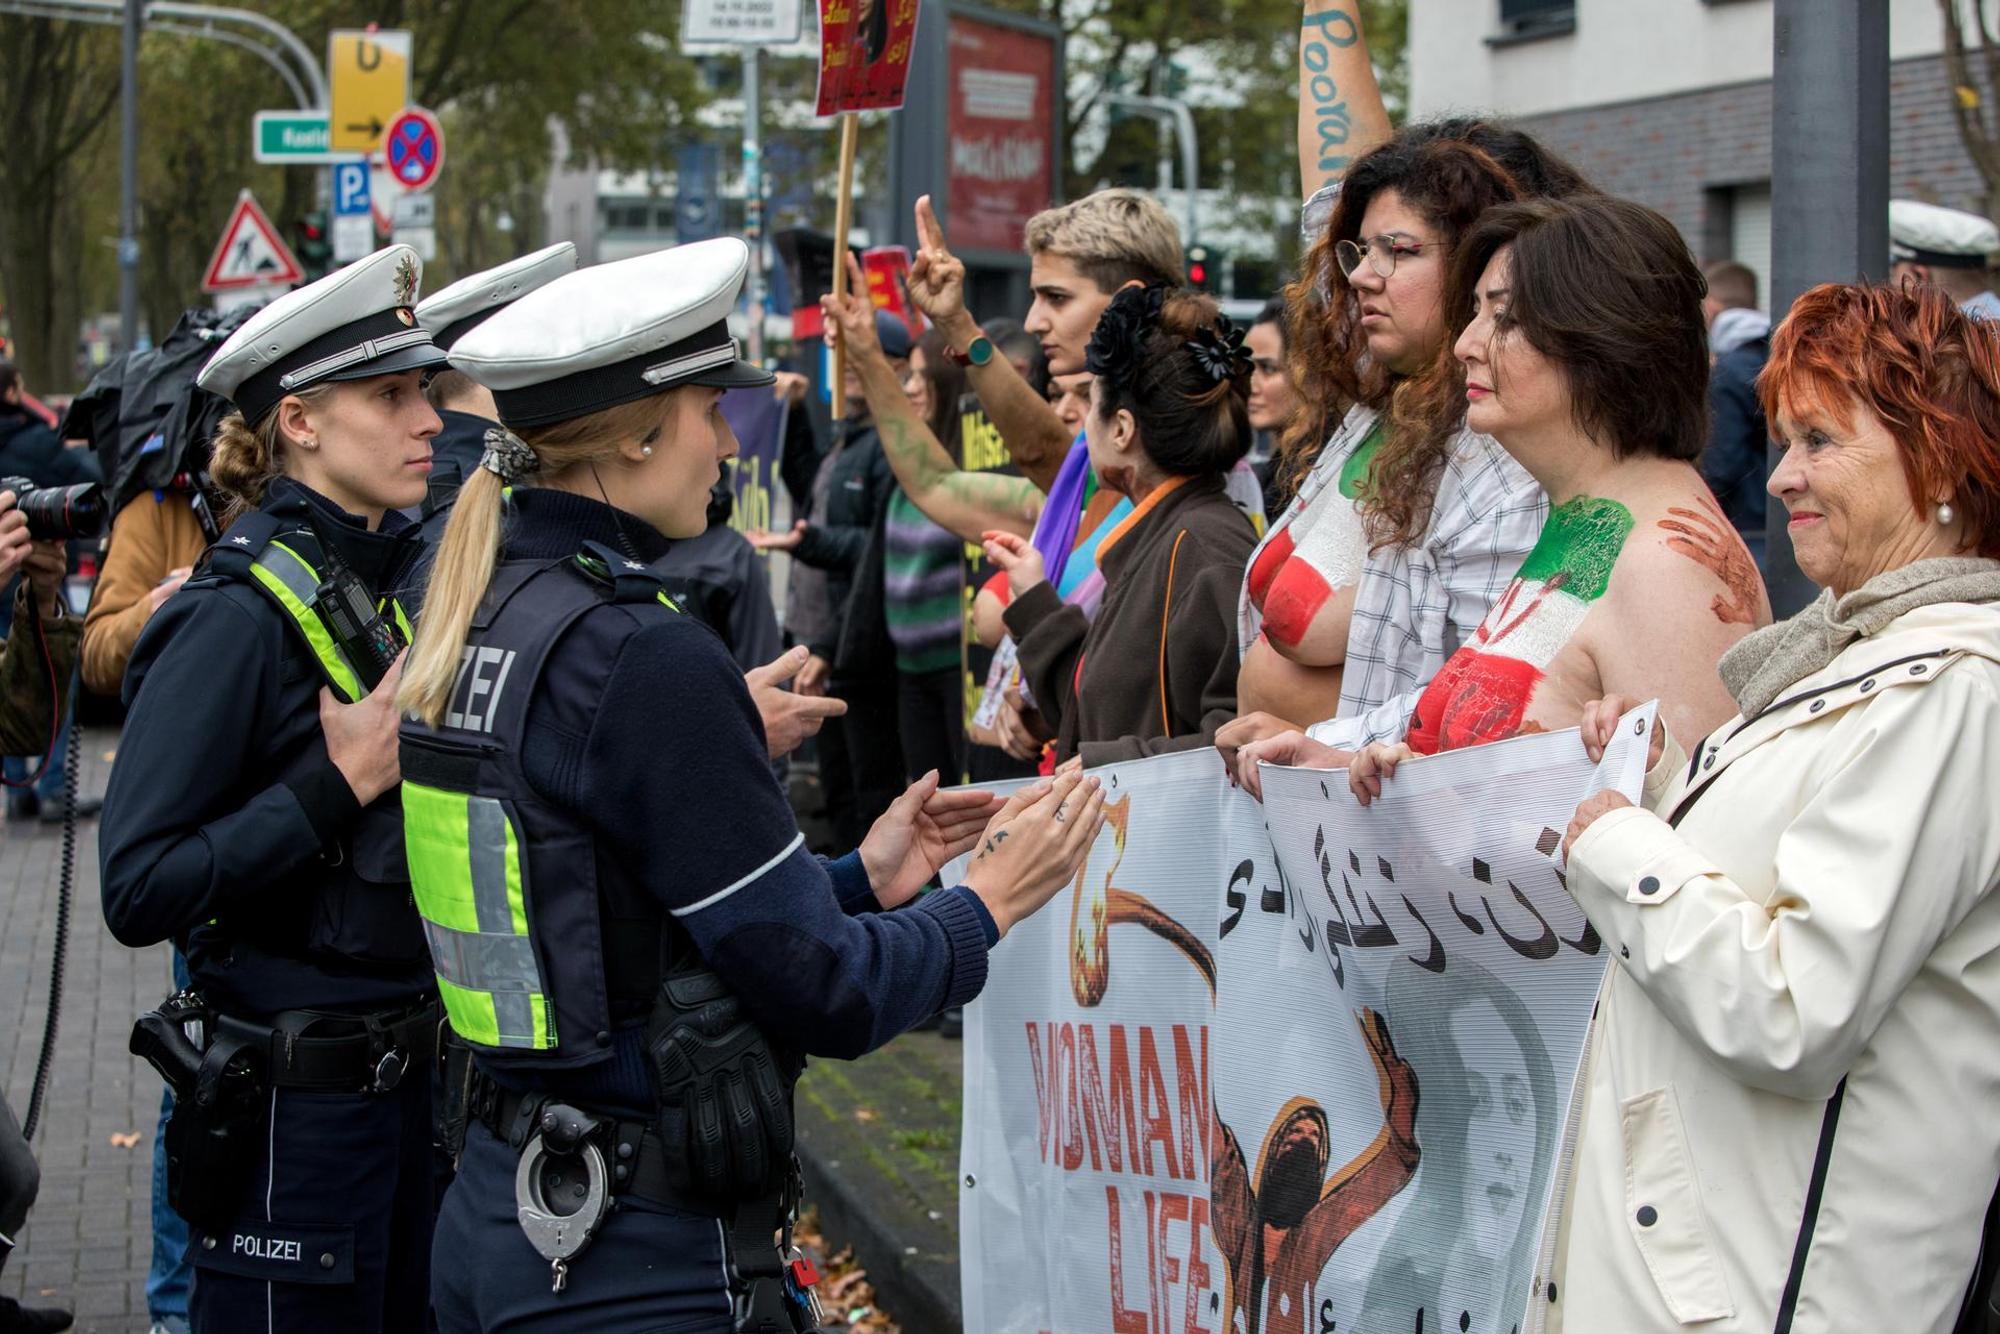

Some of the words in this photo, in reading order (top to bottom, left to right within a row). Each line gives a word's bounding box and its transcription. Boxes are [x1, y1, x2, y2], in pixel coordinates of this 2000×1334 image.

[340, 162, 364, 210] P
[445, 645, 517, 733] ZEI
[232, 1233, 302, 1261] POLIZEI
[1105, 1184, 1211, 1334] LIFE
